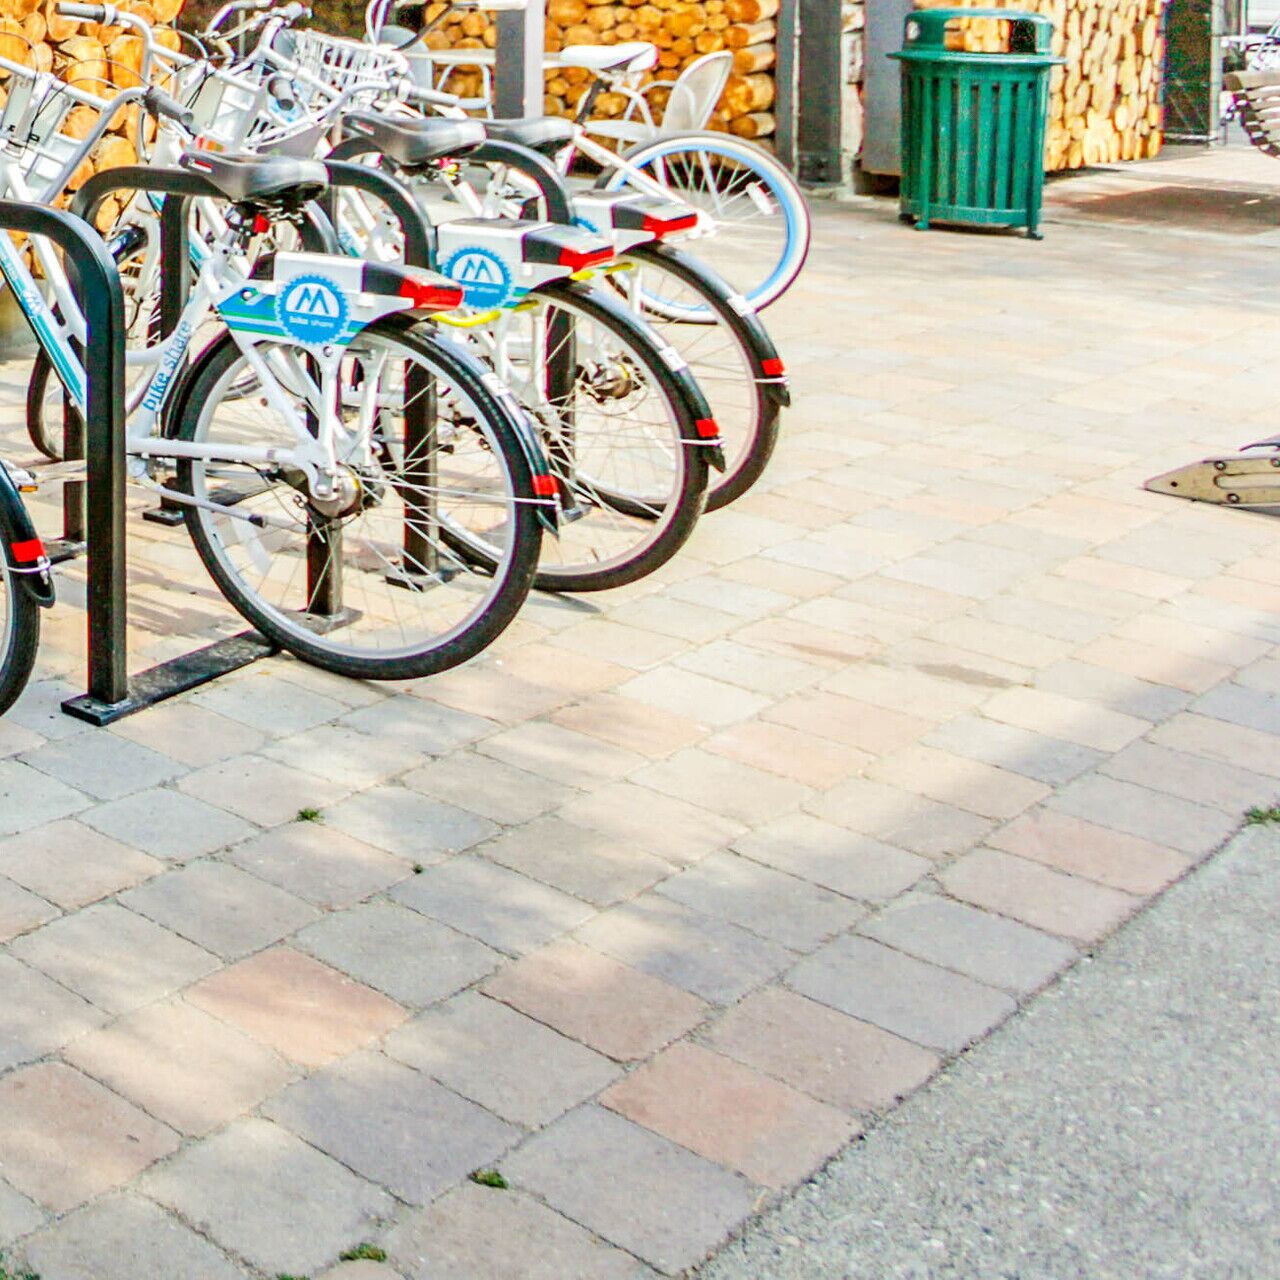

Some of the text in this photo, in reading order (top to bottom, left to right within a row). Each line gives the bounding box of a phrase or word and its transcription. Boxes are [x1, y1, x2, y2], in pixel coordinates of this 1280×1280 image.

[289, 315, 308, 325] bike
[142, 321, 191, 412] bike share
